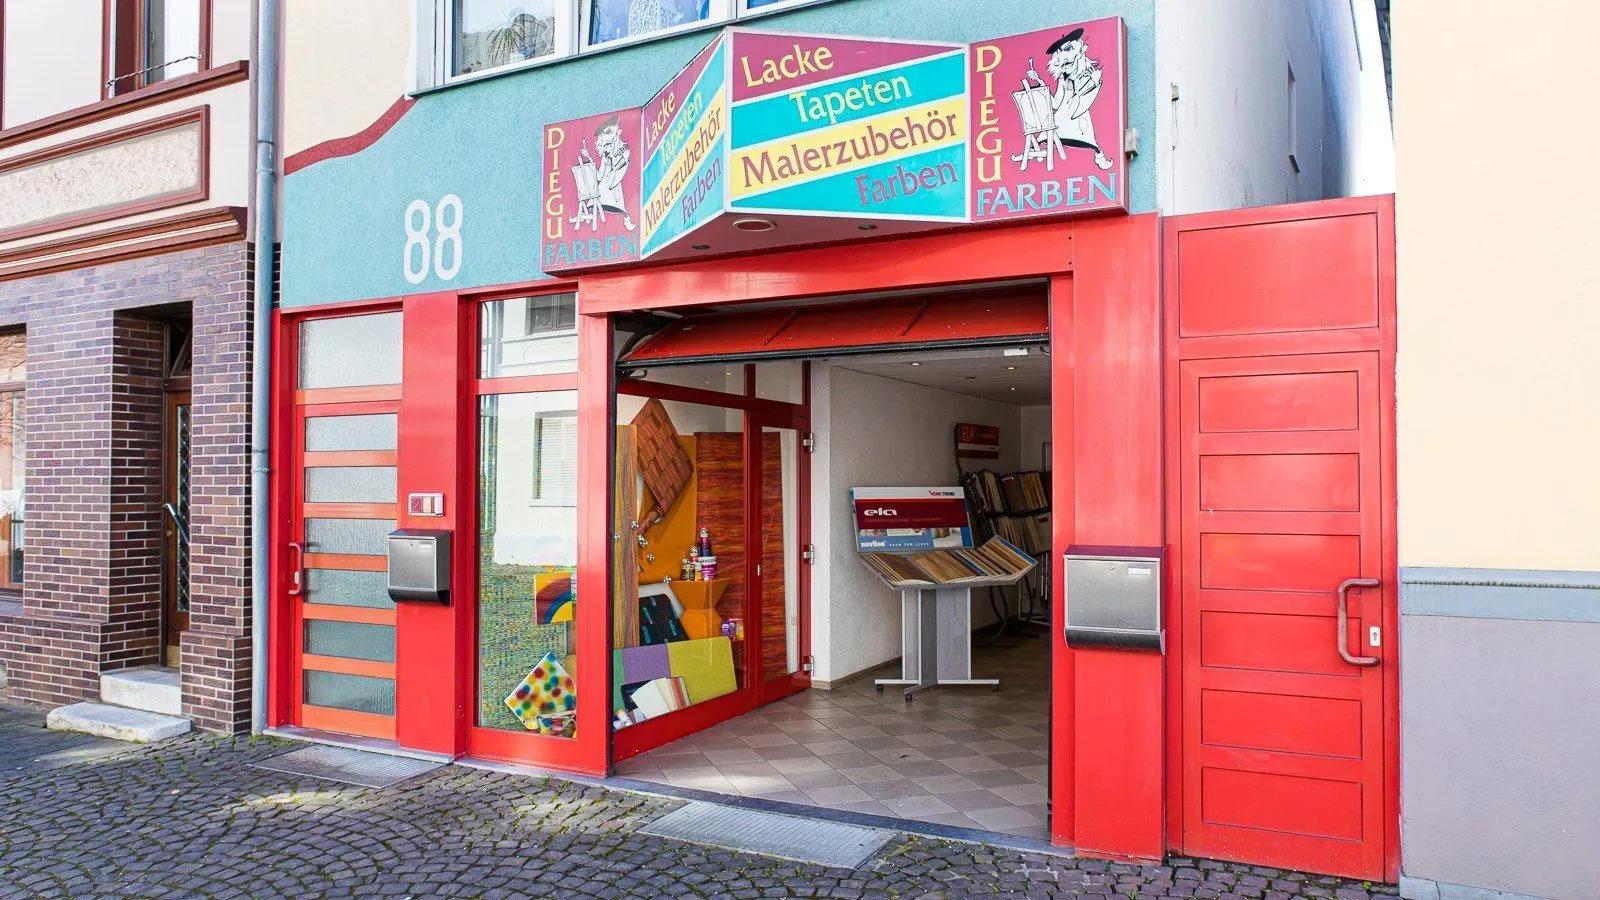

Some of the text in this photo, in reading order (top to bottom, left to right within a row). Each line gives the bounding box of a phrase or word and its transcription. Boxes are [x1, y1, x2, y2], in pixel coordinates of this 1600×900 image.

[741, 44, 835, 88] Lacke
[788, 75, 913, 124] Tapeten
[645, 91, 676, 150] Lacke
[659, 91, 702, 166] Tapeten
[975, 45, 1003, 183] DIEGU
[644, 106, 721, 237] Malerzubehör
[741, 110, 957, 188] Malerzubehör
[546, 127, 565, 239] DIEGU
[681, 157, 722, 224] Farben
[854, 161, 958, 206] Farben
[976, 172, 1117, 217] FARBEN
[403, 193, 464, 285] 88
[545, 232, 640, 267] FARBEN
